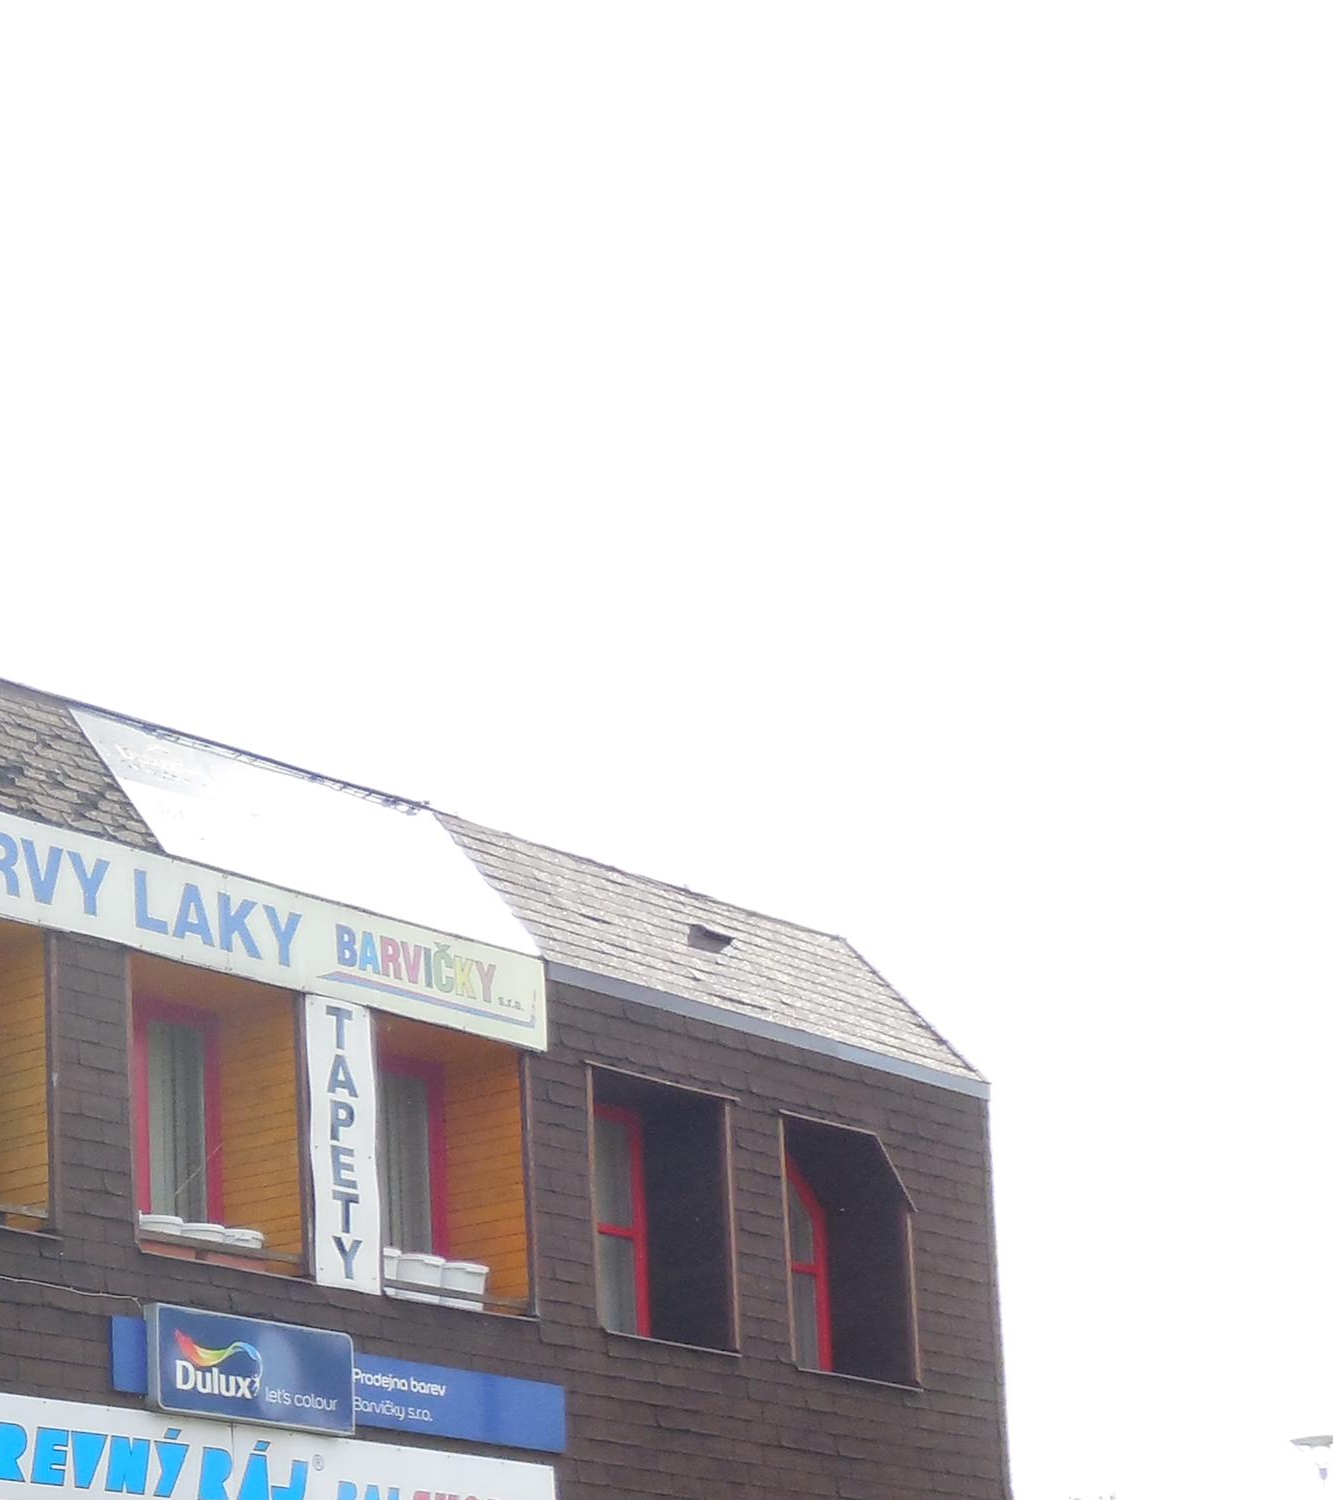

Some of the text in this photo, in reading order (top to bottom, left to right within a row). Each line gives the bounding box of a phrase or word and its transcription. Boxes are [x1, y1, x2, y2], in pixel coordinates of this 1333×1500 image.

[134, 868, 303, 968] LAKY
[335, 923, 496, 1004] BARVIČKY
[324, 1005, 358, 1281] TAPETY
[174, 1359, 253, 1399] Dulux
[352, 1368, 447, 1396] Prodejna barev
[265, 1386, 338, 1413] let's colour
[353, 1395, 433, 1422] Barvičky s.r.o.
